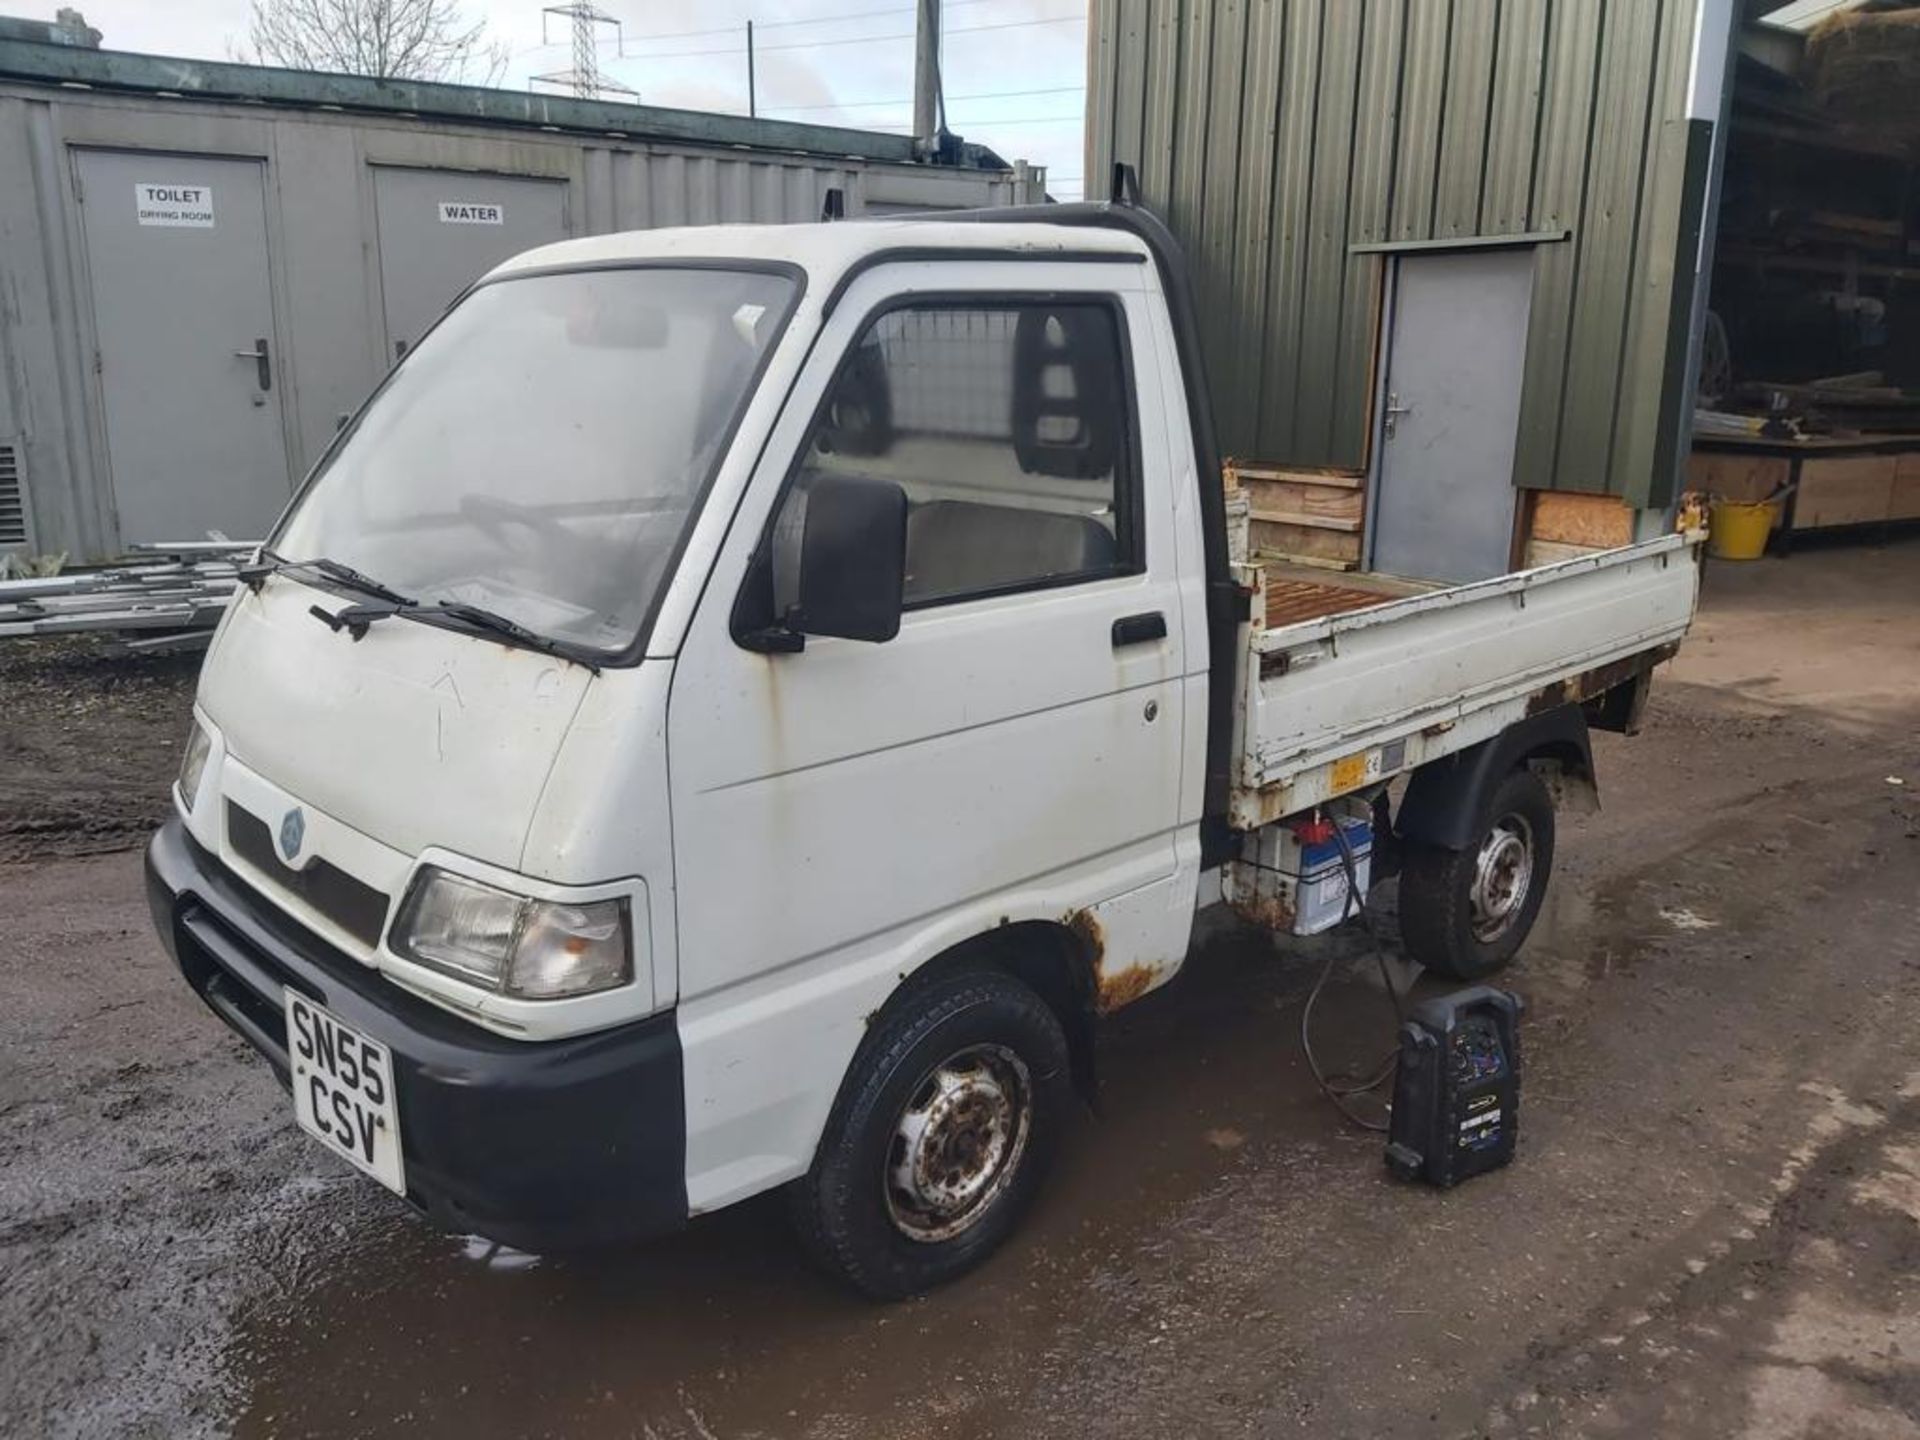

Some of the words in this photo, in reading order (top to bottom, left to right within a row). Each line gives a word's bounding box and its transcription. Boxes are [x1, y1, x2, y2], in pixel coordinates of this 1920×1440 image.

[146, 188, 202, 203] TOILET
[181, 211, 212, 221] ROOM
[445, 206, 498, 220] WATER
[293, 1001, 385, 1105] SN55
[310, 1075, 375, 1163] CSV
